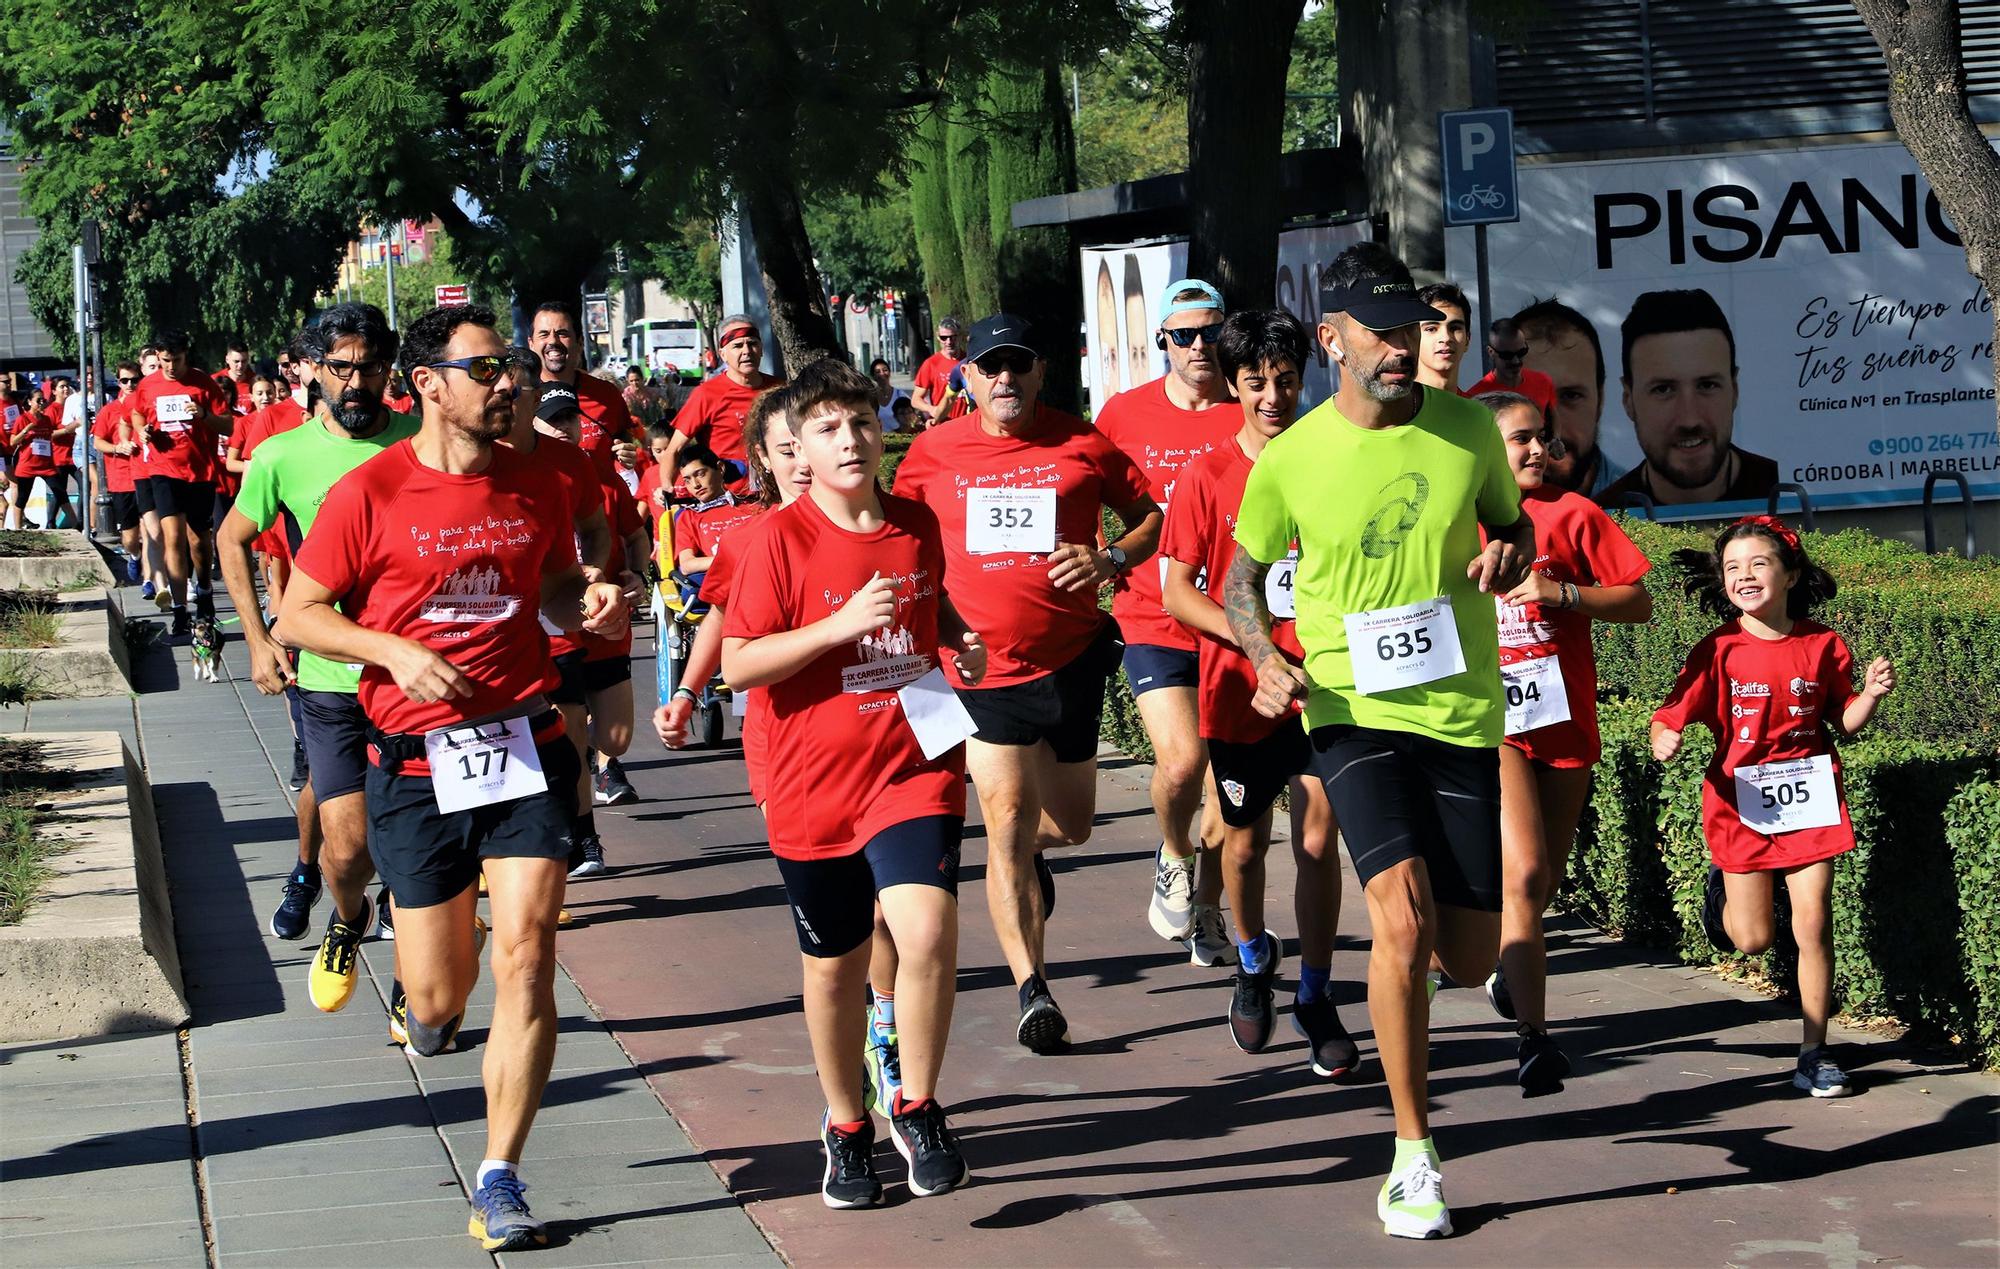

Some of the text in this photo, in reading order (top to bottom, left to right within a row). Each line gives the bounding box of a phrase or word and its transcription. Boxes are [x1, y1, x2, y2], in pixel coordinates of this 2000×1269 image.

[1460, 122, 1495, 171] P
[1796, 296, 1847, 339] Es
[1861, 344, 1962, 381] sueños
[540, 388, 576, 402] adidas
[1800, 396, 1847, 411] Clínica
[1883, 396, 1901, 407] en
[1886, 436, 1923, 455] 900
[1928, 434, 1964, 451] 264
[1793, 463, 1884, 483] CÓRDOBA
[989, 507, 1034, 528] 352
[411, 526, 431, 542] Pies
[439, 526, 464, 542] para
[436, 601, 467, 609] CARRERA
[468, 600, 508, 609] SOLIDARIA
[1371, 617, 1400, 625] CARRERA
[1401, 608, 1434, 620] SOLIDARIA
[1377, 626, 1433, 661] 635
[847, 660, 922, 681] IX CARRERA SOLIDARIA
[1736, 681, 1769, 693] califas
[858, 700, 889, 711] ACPACYS
[458, 747, 509, 780] 177
[1761, 780, 1810, 808] 505
